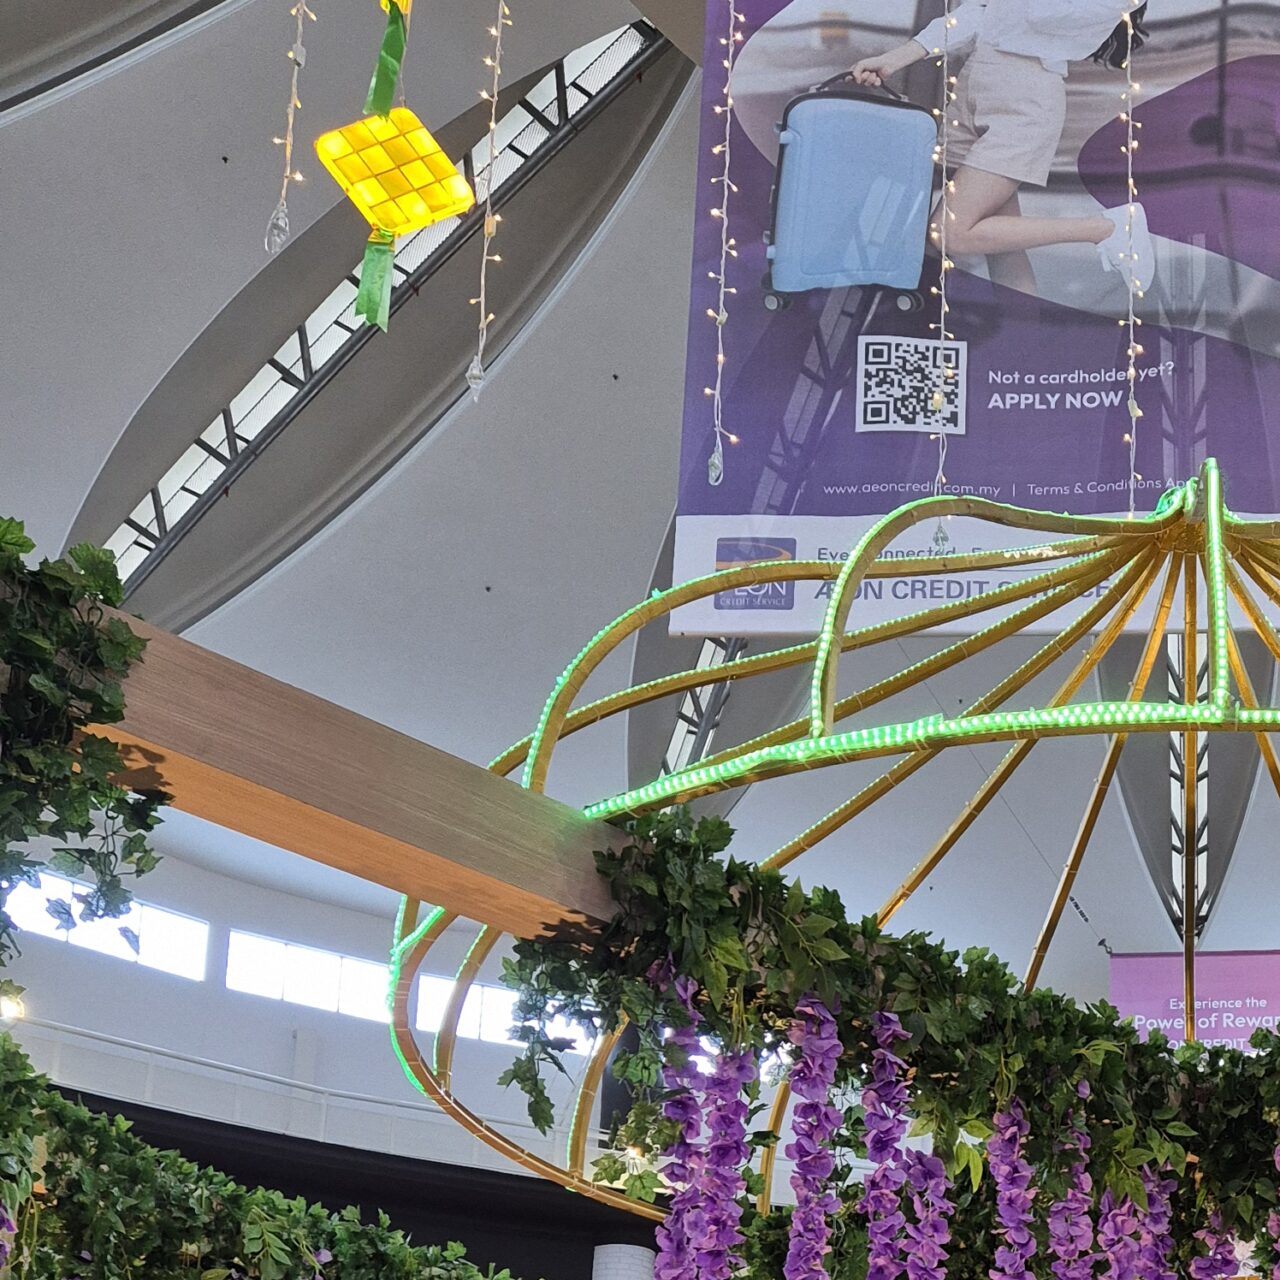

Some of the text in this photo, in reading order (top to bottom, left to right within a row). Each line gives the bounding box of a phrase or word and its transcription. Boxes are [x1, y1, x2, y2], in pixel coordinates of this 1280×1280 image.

[988, 370, 1020, 384] Not
[1024, 374, 1036, 384] a
[1138, 361, 1175, 382] yet?
[988, 390, 1124, 409] APPLY NOW
[1027, 484, 1071, 496] Terms
[1074, 482, 1084, 494] &
[891, 579, 990, 600] CREDIT
[1169, 997, 1268, 1010] Exerience the
[1134, 1014, 1188, 1029] Powe
[1198, 1013, 1219, 1028] of
